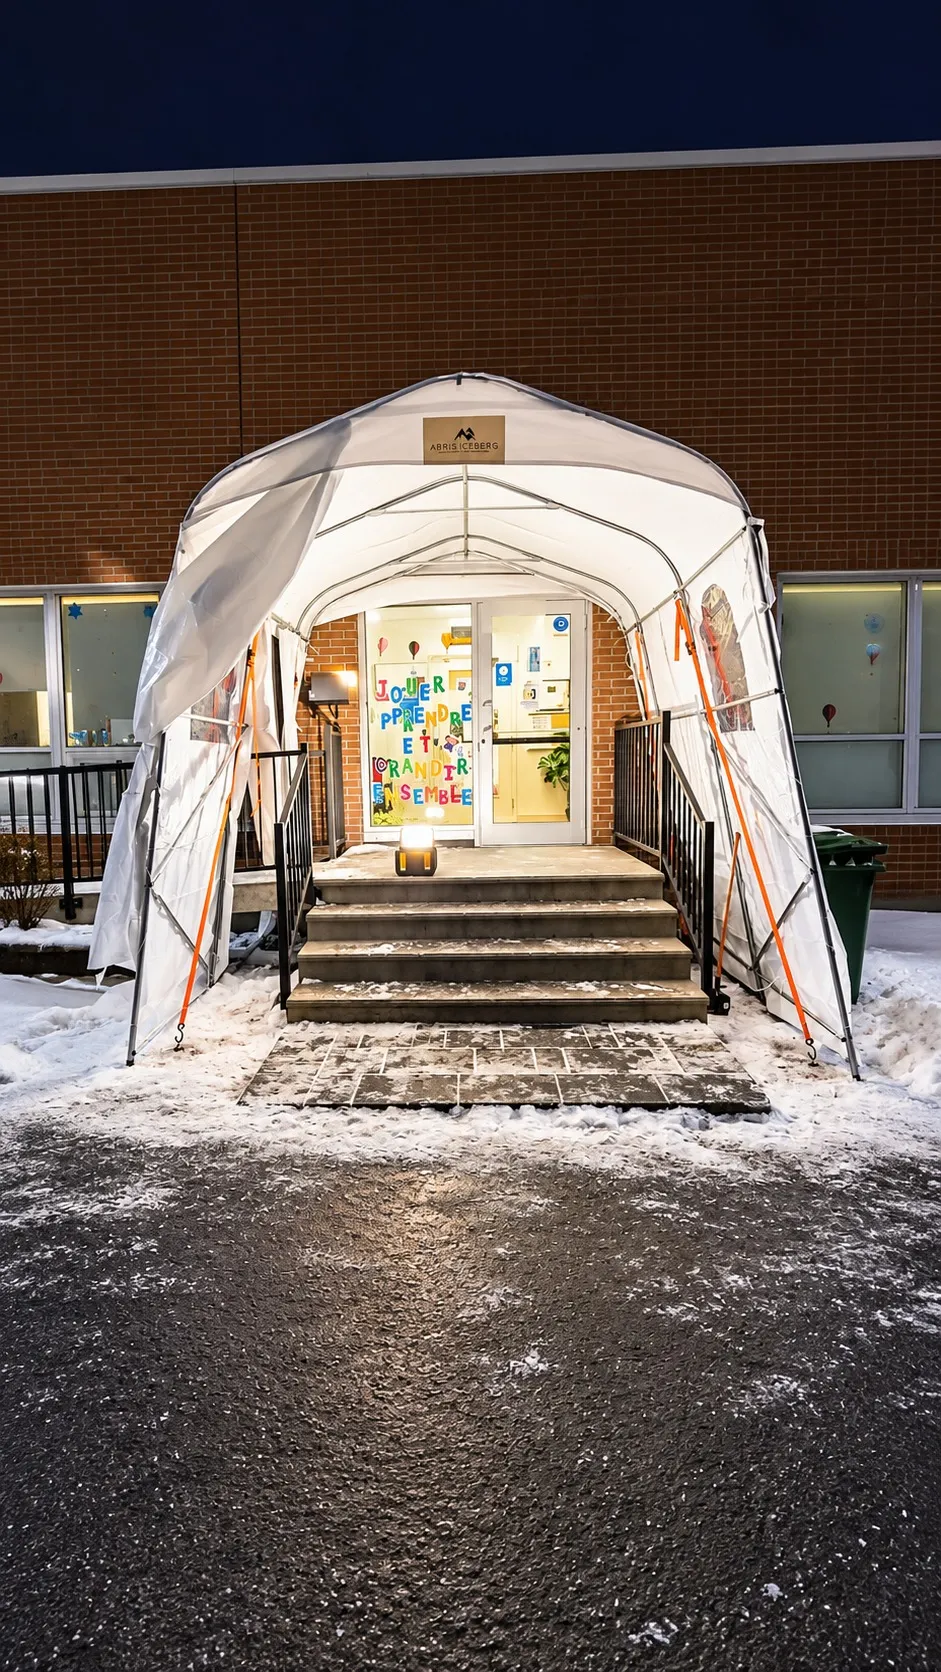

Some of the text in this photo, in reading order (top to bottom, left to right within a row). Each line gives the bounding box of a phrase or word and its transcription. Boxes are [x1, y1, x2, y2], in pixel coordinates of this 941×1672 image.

[430, 442, 499, 451] ABRIS ICEBERG
[376, 676, 445, 703] JOUER
[403, 735, 431, 754] ET
[373, 783, 472, 805] ENSEMBLE
